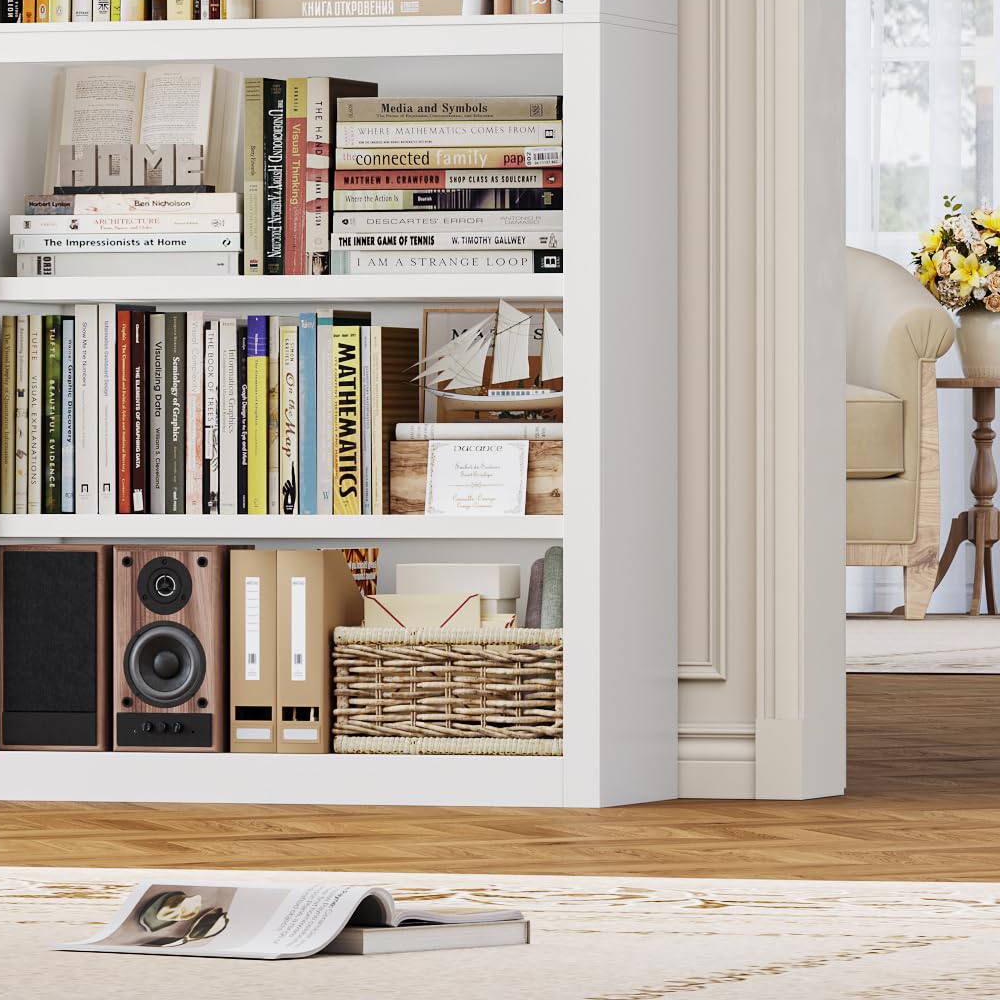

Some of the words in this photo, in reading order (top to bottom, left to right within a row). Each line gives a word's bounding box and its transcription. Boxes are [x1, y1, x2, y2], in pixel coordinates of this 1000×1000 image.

[302, 1, 332, 17] КНИГА
[335, 0, 394, 16] ОТКРОВЕНИЯ
[381, 103, 413, 113] Media
[417, 103, 437, 113] and
[442, 103, 488, 114] Symbols
[292, 123, 301, 159] Visual
[59, 144, 204, 186] HOME
[356, 151, 430, 166] connected
[436, 150, 487, 168] family
[290, 160, 301, 205] Thinking
[344, 176, 382, 184] MATTHEW
[386, 176, 393, 184] B.
[397, 176, 440, 184] CRAWFORD
[501, 175, 537, 183] SOULCRAFT
[44, 239, 62, 247] The
[66, 239, 140, 248] Impressionists
[158, 238, 187, 246] Home
[339, 237, 351, 246] THE
[353, 237, 374, 246] INNER
[377, 237, 396, 246] GAME
[399, 236, 408, 245] OF
[410, 236, 434, 245] TENNIS
[357, 258, 360, 266] I
[368, 258, 388, 266] AM
[396, 258, 403, 266] A
[411, 257, 479, 266] STRANGE
[487, 257, 528, 266] LOOP
[153, 341, 162, 391] Visualizing
[172, 356, 180, 395] Semiology
[285, 372, 295, 395] On
[173, 397, 180, 406] of
[289, 399, 297, 416] the
[171, 407, 180, 442] Graphics
[338, 342, 357, 498] MATHEMATICS
[282, 408, 296, 457] Map
